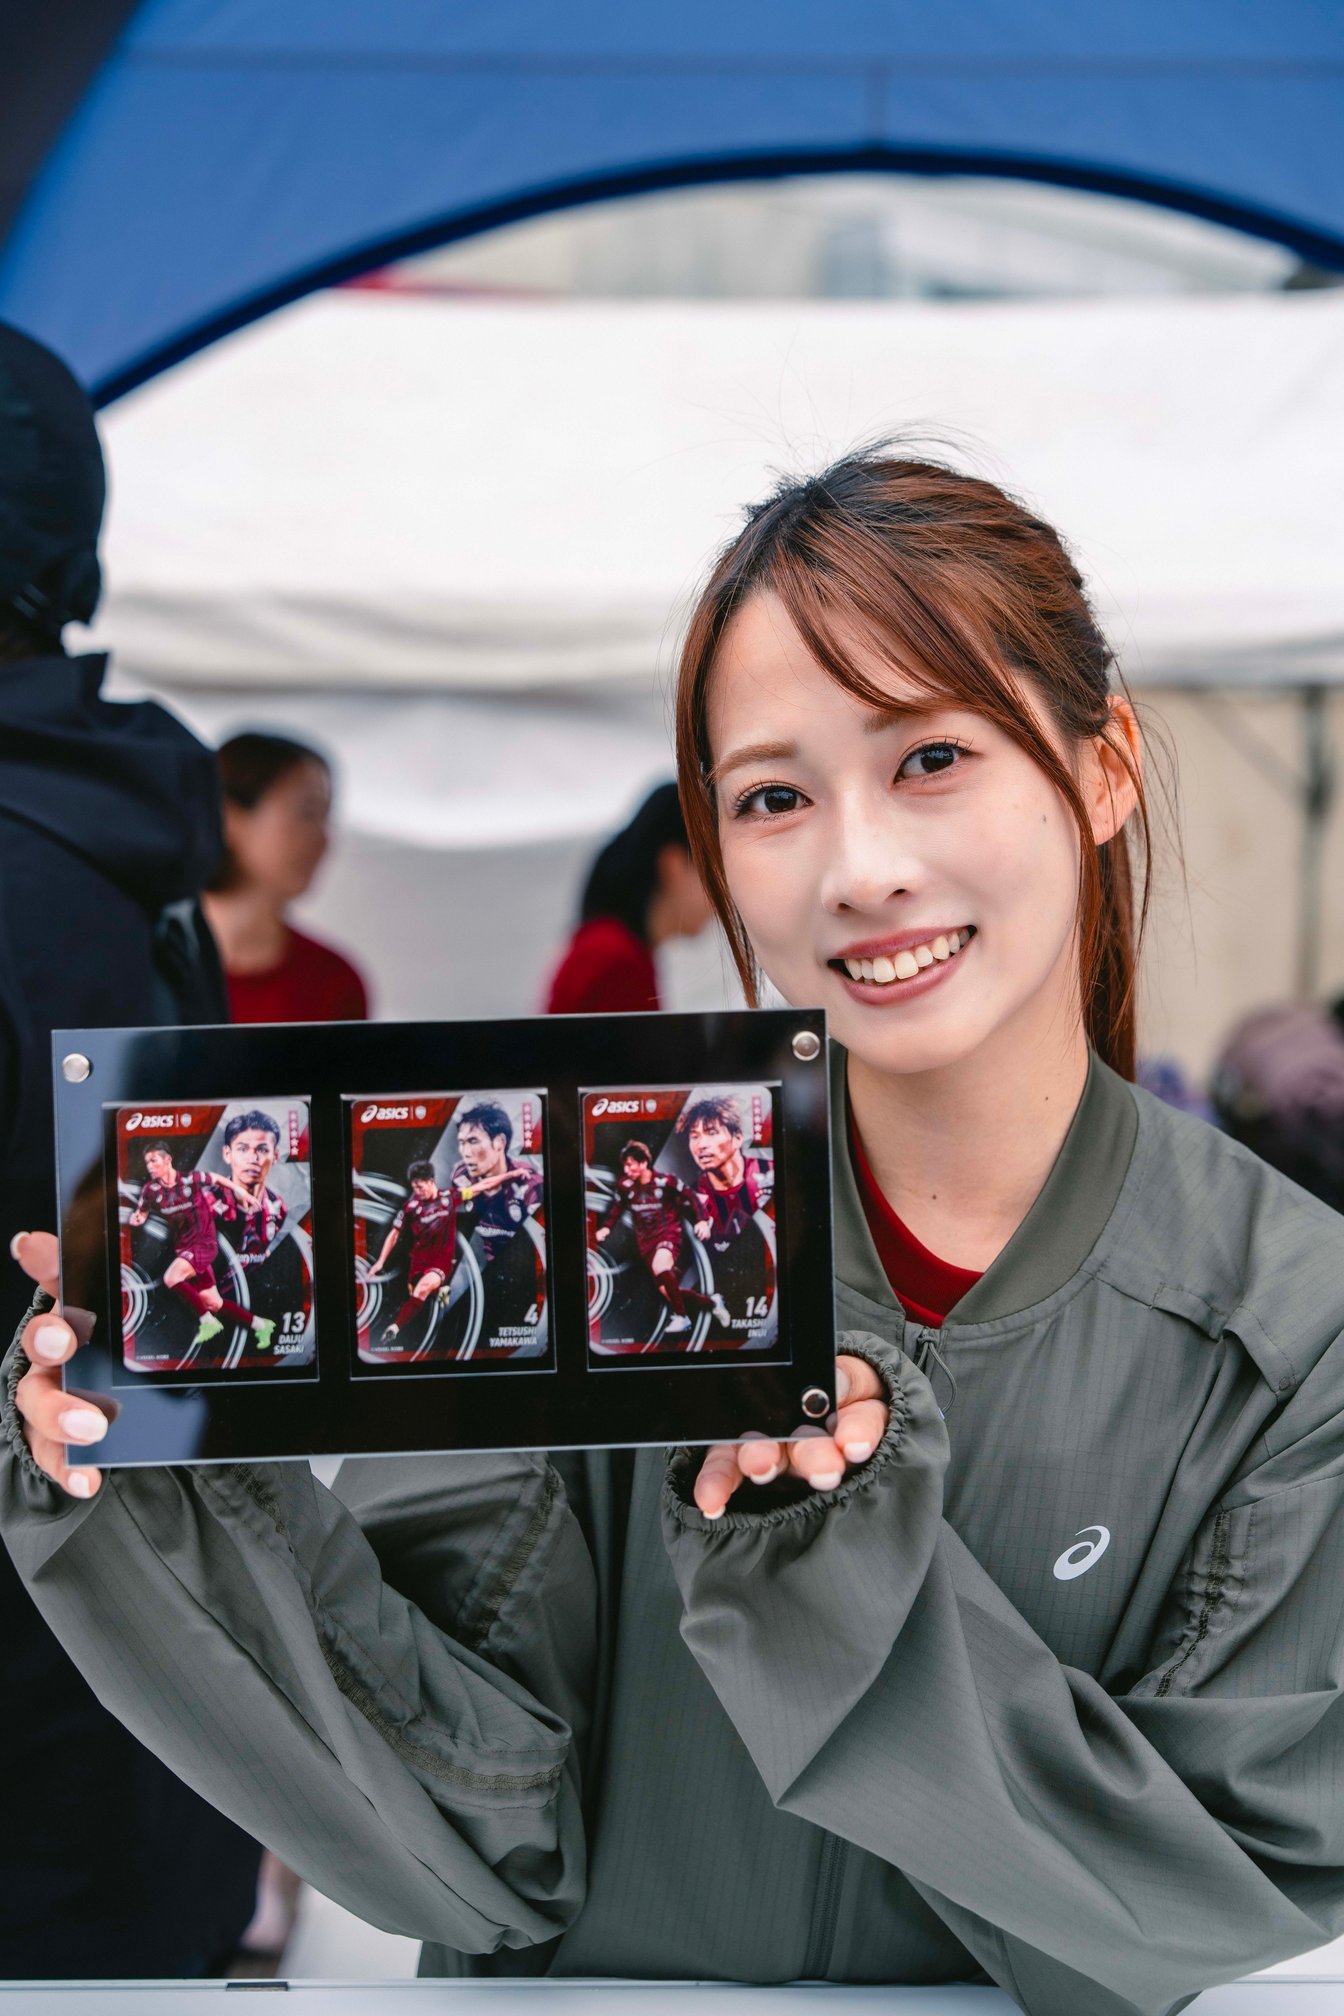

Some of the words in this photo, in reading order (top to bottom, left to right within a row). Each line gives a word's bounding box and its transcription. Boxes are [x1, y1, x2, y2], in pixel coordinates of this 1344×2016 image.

[746, 1296, 768, 1317] 14
[524, 1303, 538, 1325] 4
[282, 1311, 306, 1333] 13
[731, 1318, 767, 1329] TAKASHI
[498, 1326, 537, 1337] TETSUSHI
[747, 1328, 768, 1338] INUI
[278, 1334, 304, 1345] DAIJU
[489, 1337, 538, 1347] YAMAKAWA
[273, 1344, 305, 1356] SASAKI
